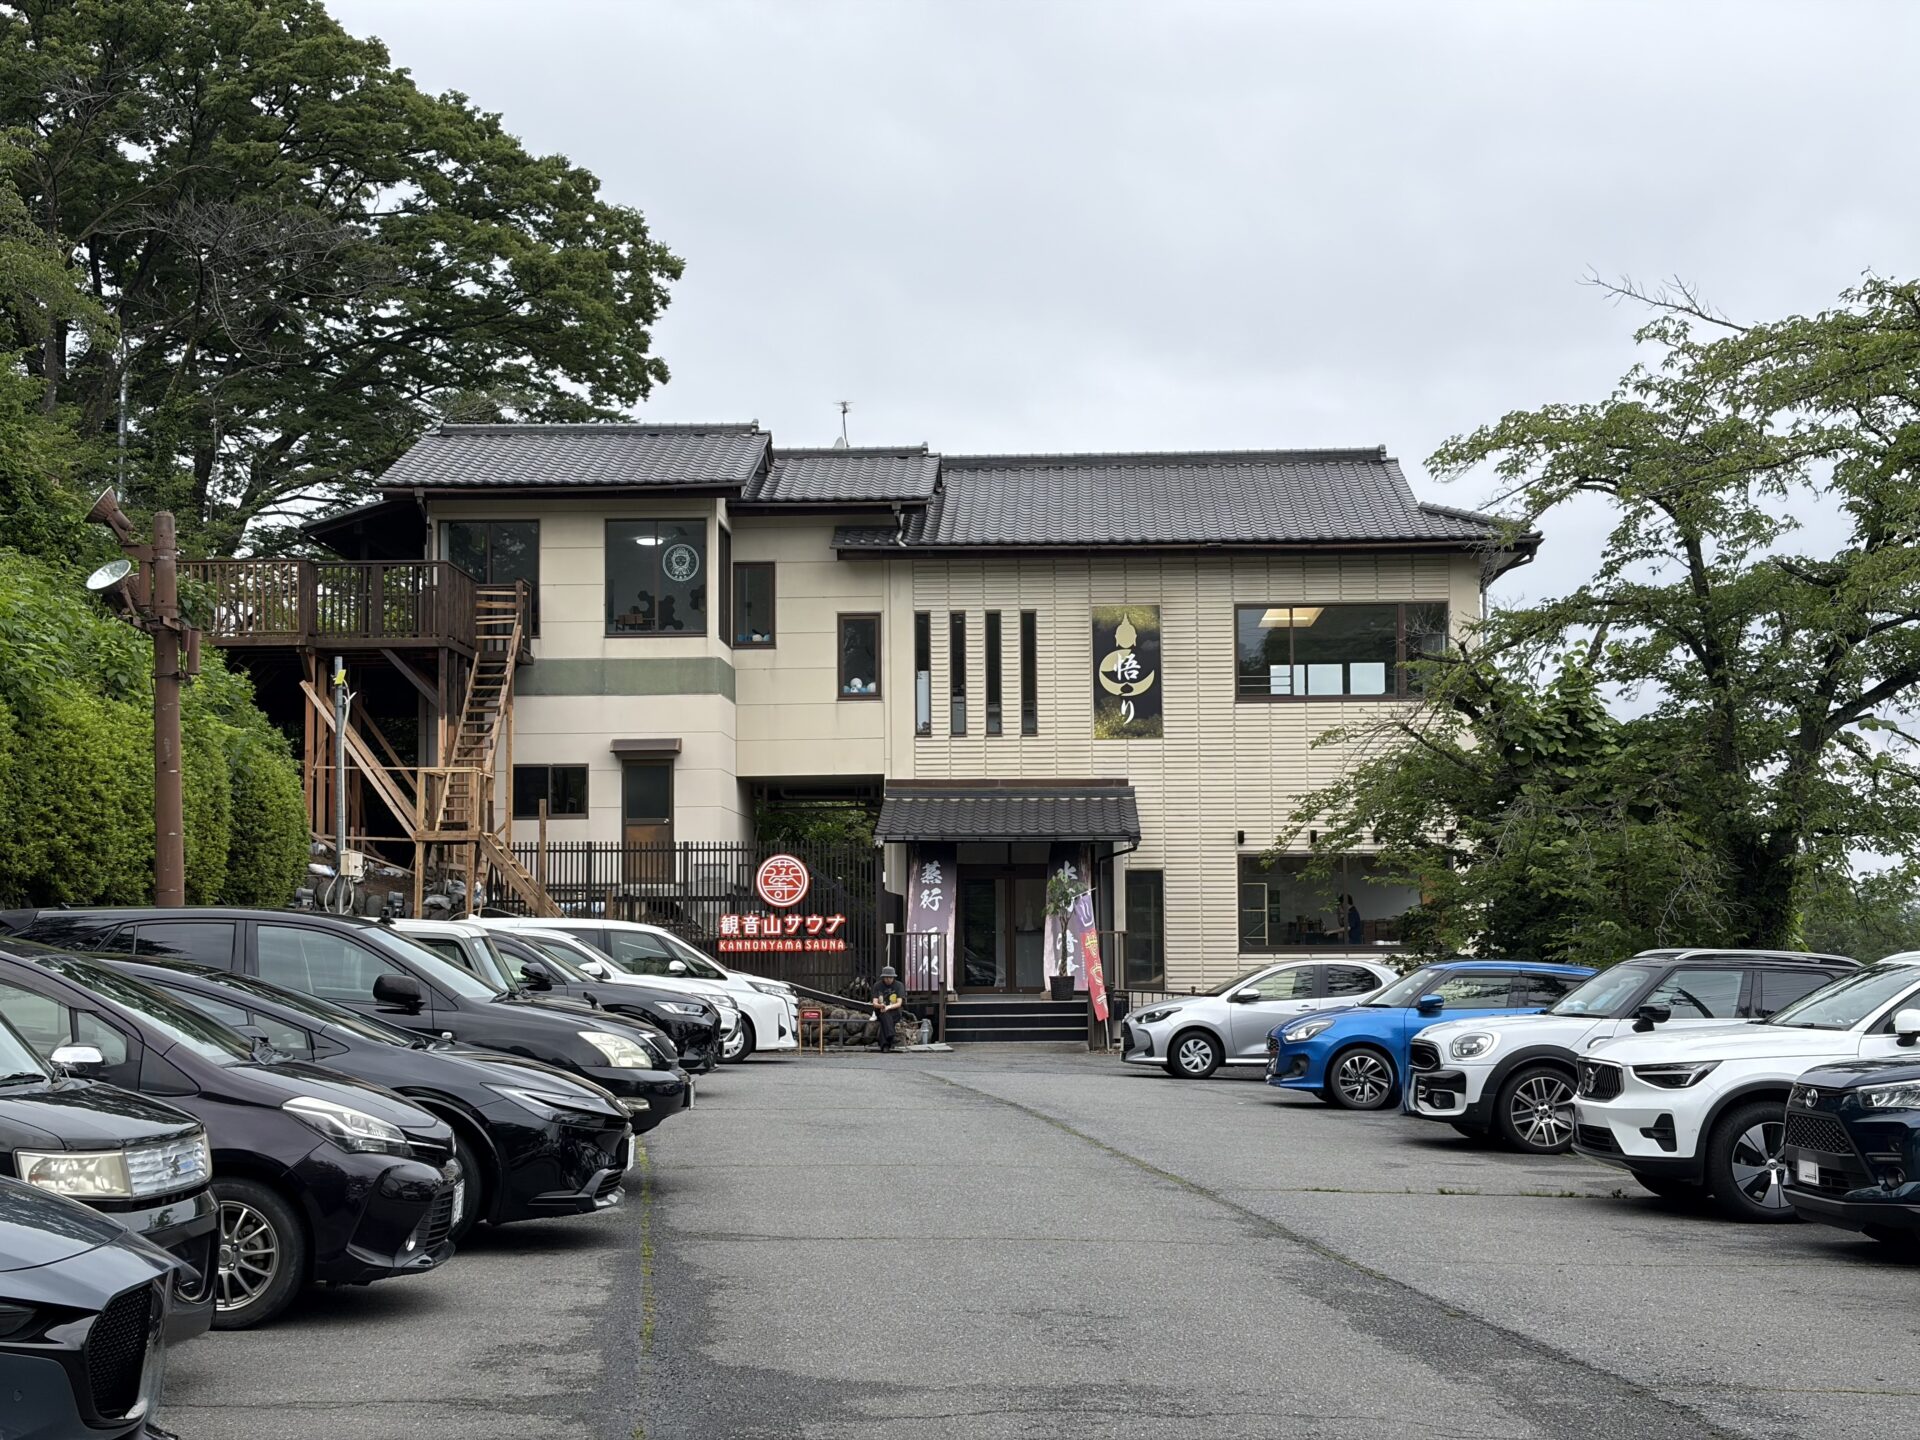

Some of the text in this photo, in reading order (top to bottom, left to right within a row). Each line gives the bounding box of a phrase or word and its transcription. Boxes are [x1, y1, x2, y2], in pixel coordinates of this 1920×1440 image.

[1113, 652, 1141, 726] 悟り
[720, 914, 846, 935] 観音山サウナ
[719, 939, 845, 951] KANNONYAMA SAUNA
